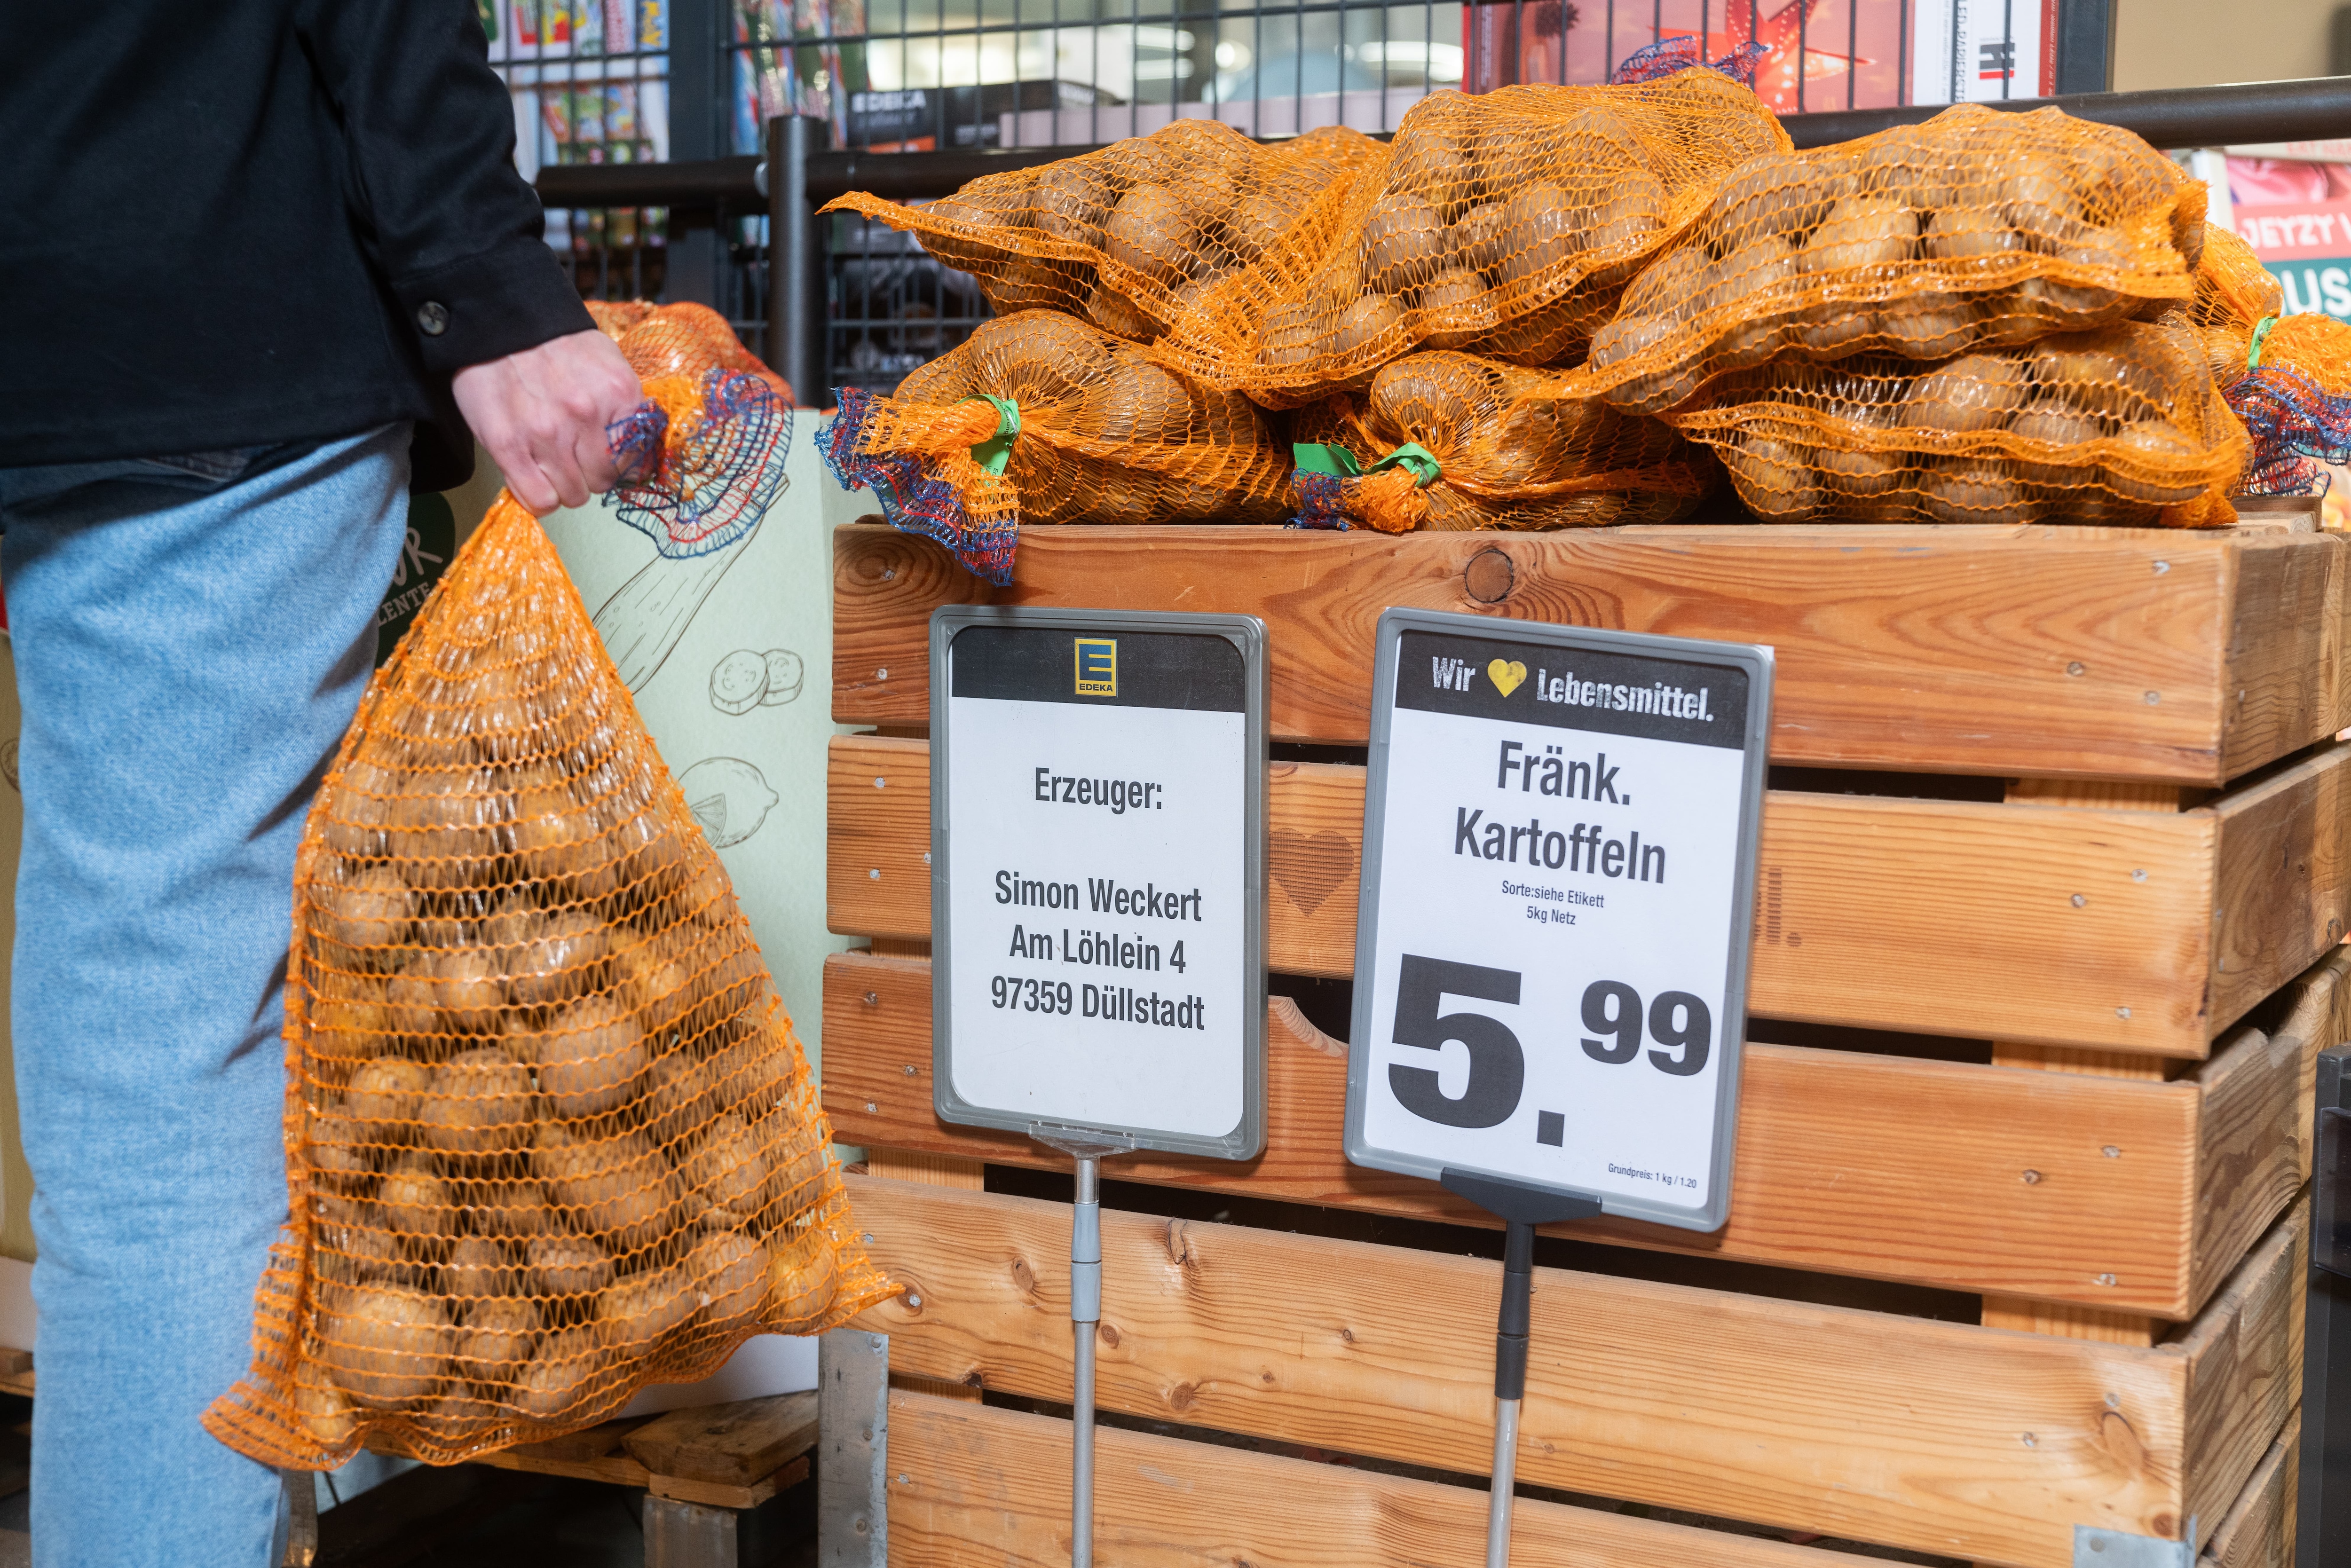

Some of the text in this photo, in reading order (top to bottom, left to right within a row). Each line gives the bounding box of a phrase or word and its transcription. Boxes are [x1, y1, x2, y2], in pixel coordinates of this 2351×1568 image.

[1079, 683, 1113, 692] EDEKA
[1432, 656, 1714, 722] Wir Lebensmittel.
[1035, 767, 1162, 815] Erzeuger:
[1497, 740, 1631, 806] Fränk.
[1454, 806, 1666, 884] Kartoffeln
[995, 870, 1202, 922] Simon Weckert
[1501, 880, 1604, 908] Sorte:siehe Etikett
[1527, 906, 1576, 925] 5kg Netz
[1009, 924, 1186, 974] Am Löhlein 4
[992, 975, 1205, 1031] 97359 Düllstadt
[1608, 1163, 1697, 1189] Grundpreis: 1 kg / 1.20
